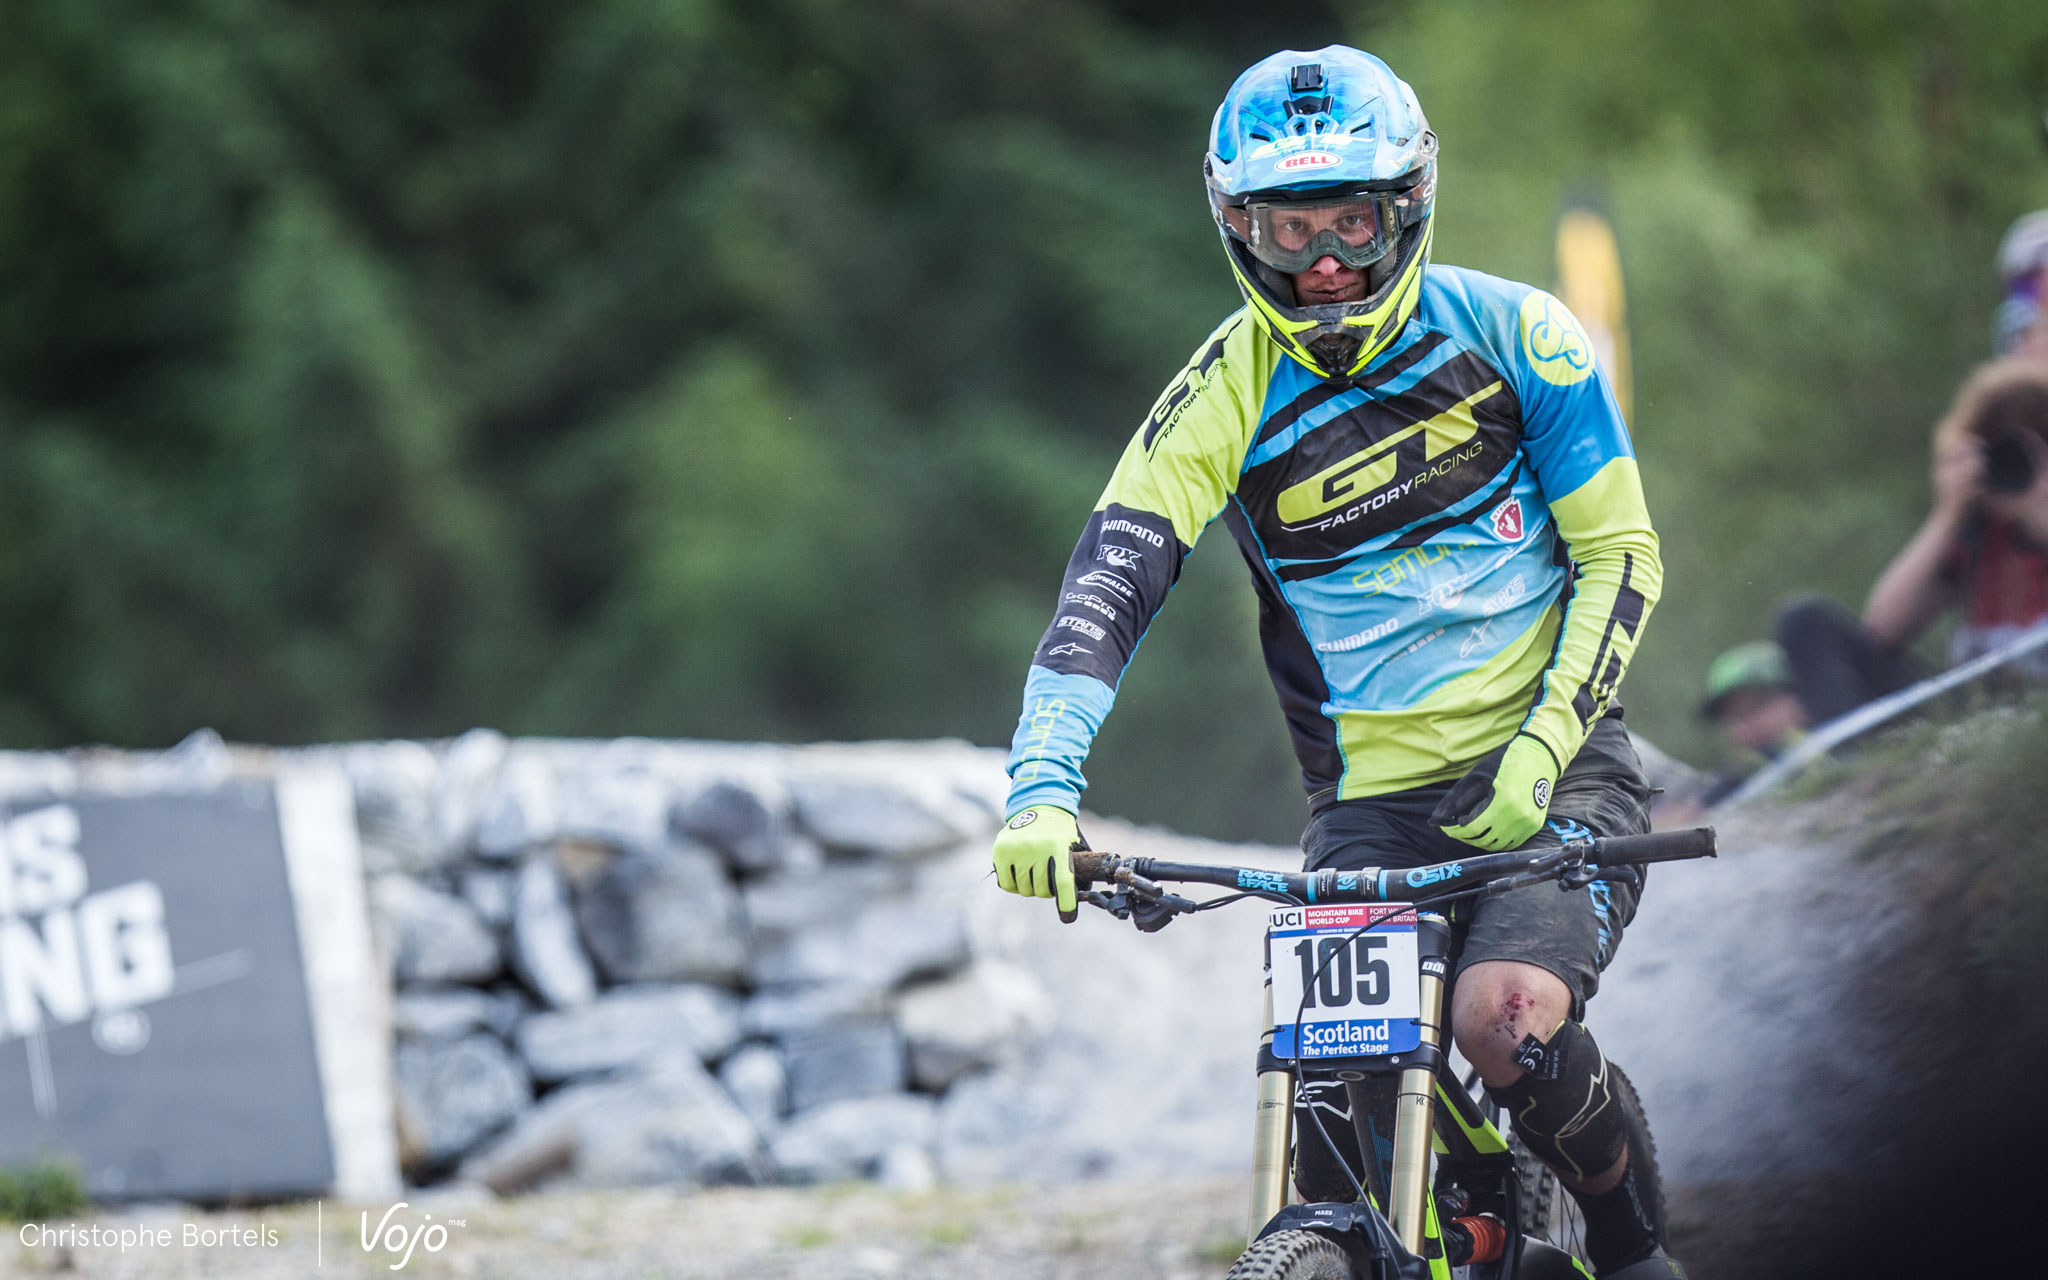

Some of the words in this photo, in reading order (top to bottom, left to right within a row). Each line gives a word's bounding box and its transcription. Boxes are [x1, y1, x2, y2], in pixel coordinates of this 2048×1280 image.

[1285, 156, 1331, 168] BELL
[1162, 386, 1201, 440] FACTORY
[1201, 361, 1228, 392] RACING
[1277, 380, 1502, 524] GT
[1318, 479, 1413, 532] FACTORY
[1414, 441, 1484, 489] RACING
[1100, 519, 1165, 548] SHIMANO
[1097, 544, 1143, 571] FOX
[1317, 617, 1399, 652] SHIMANO
[1238, 869, 1284, 881] RACE
[1246, 878, 1289, 893] FACE
[1272, 911, 1303, 928] UCI
[1308, 909, 1347, 917] MOUNTAIN
[1348, 908, 1364, 916] BIKE
[1369, 907, 1387, 915] FORT
[1392, 914, 1418, 923] BRITAIN
[1308, 917, 1334, 926] WORLD
[1294, 936, 1390, 1009] 105
[1303, 1019, 1389, 1045] Scotland
[1303, 1046, 1321, 1056] The
[1322, 1044, 1358, 1055] Perfect
[1360, 1043, 1389, 1054] Stage
